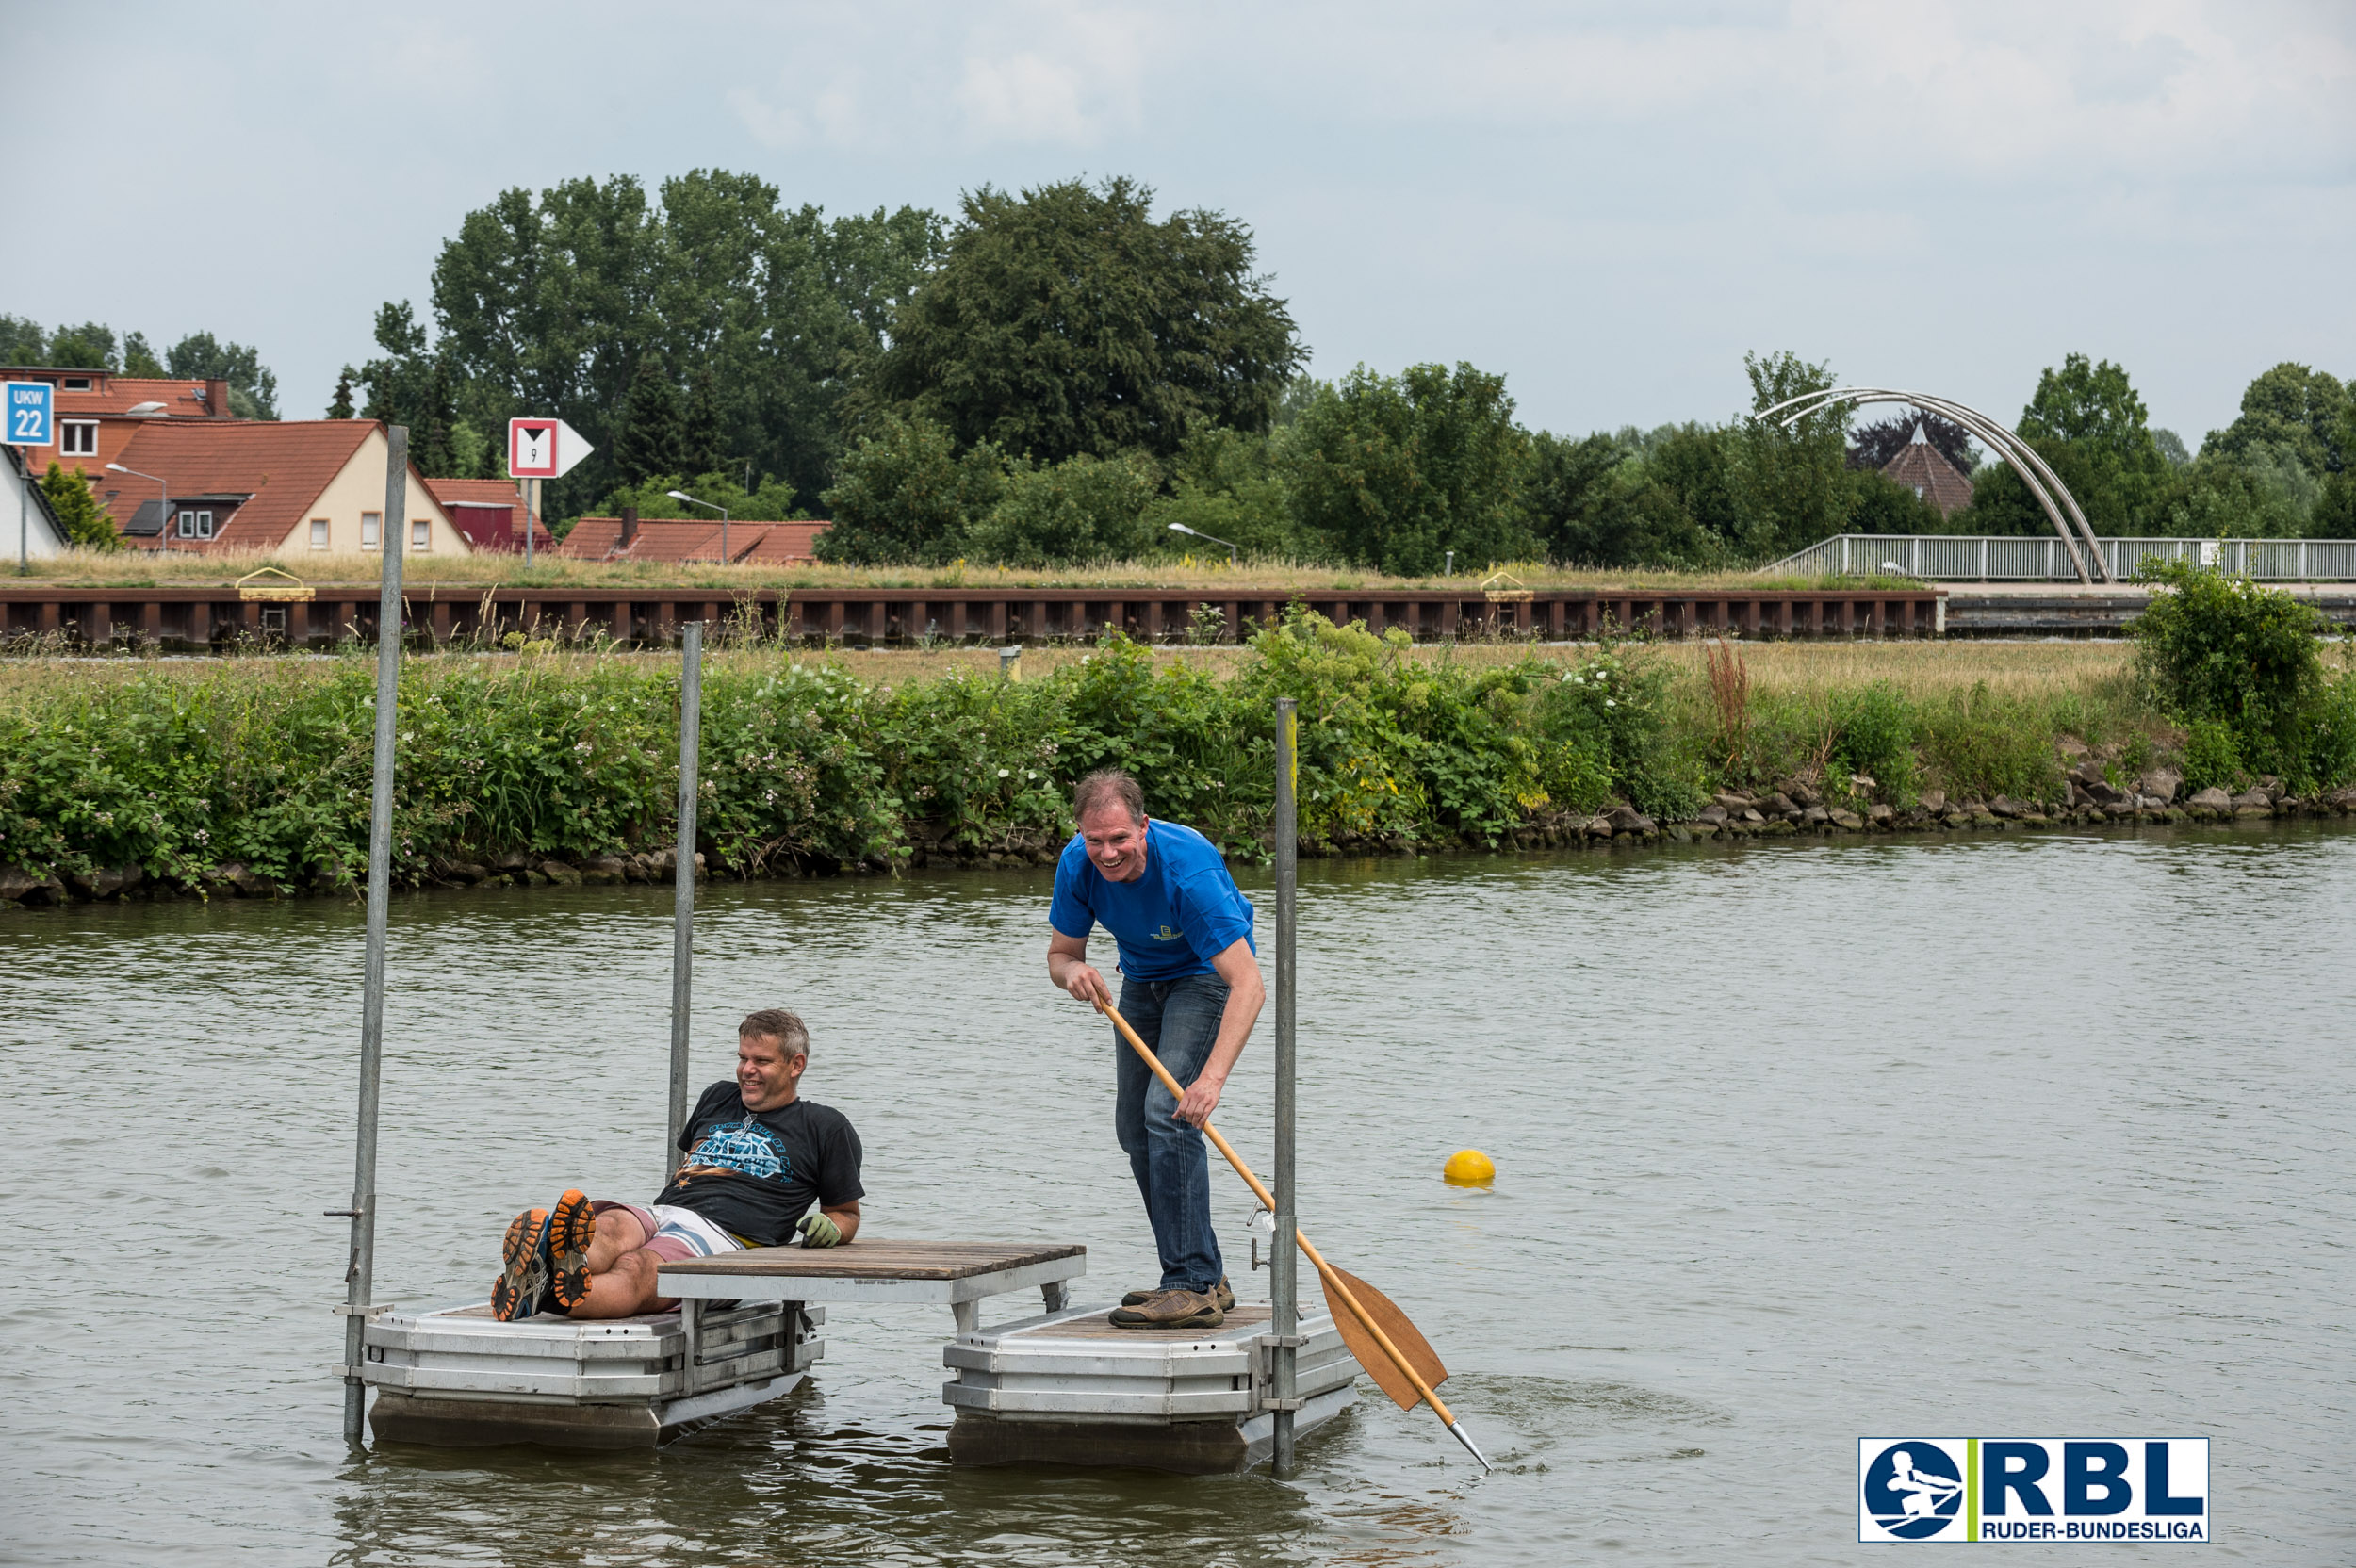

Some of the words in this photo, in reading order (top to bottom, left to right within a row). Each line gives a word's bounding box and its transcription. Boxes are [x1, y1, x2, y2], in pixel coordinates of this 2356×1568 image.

[13, 390, 44, 405] UKW
[15, 409, 43, 437] 22
[531, 448, 537, 463] 9
